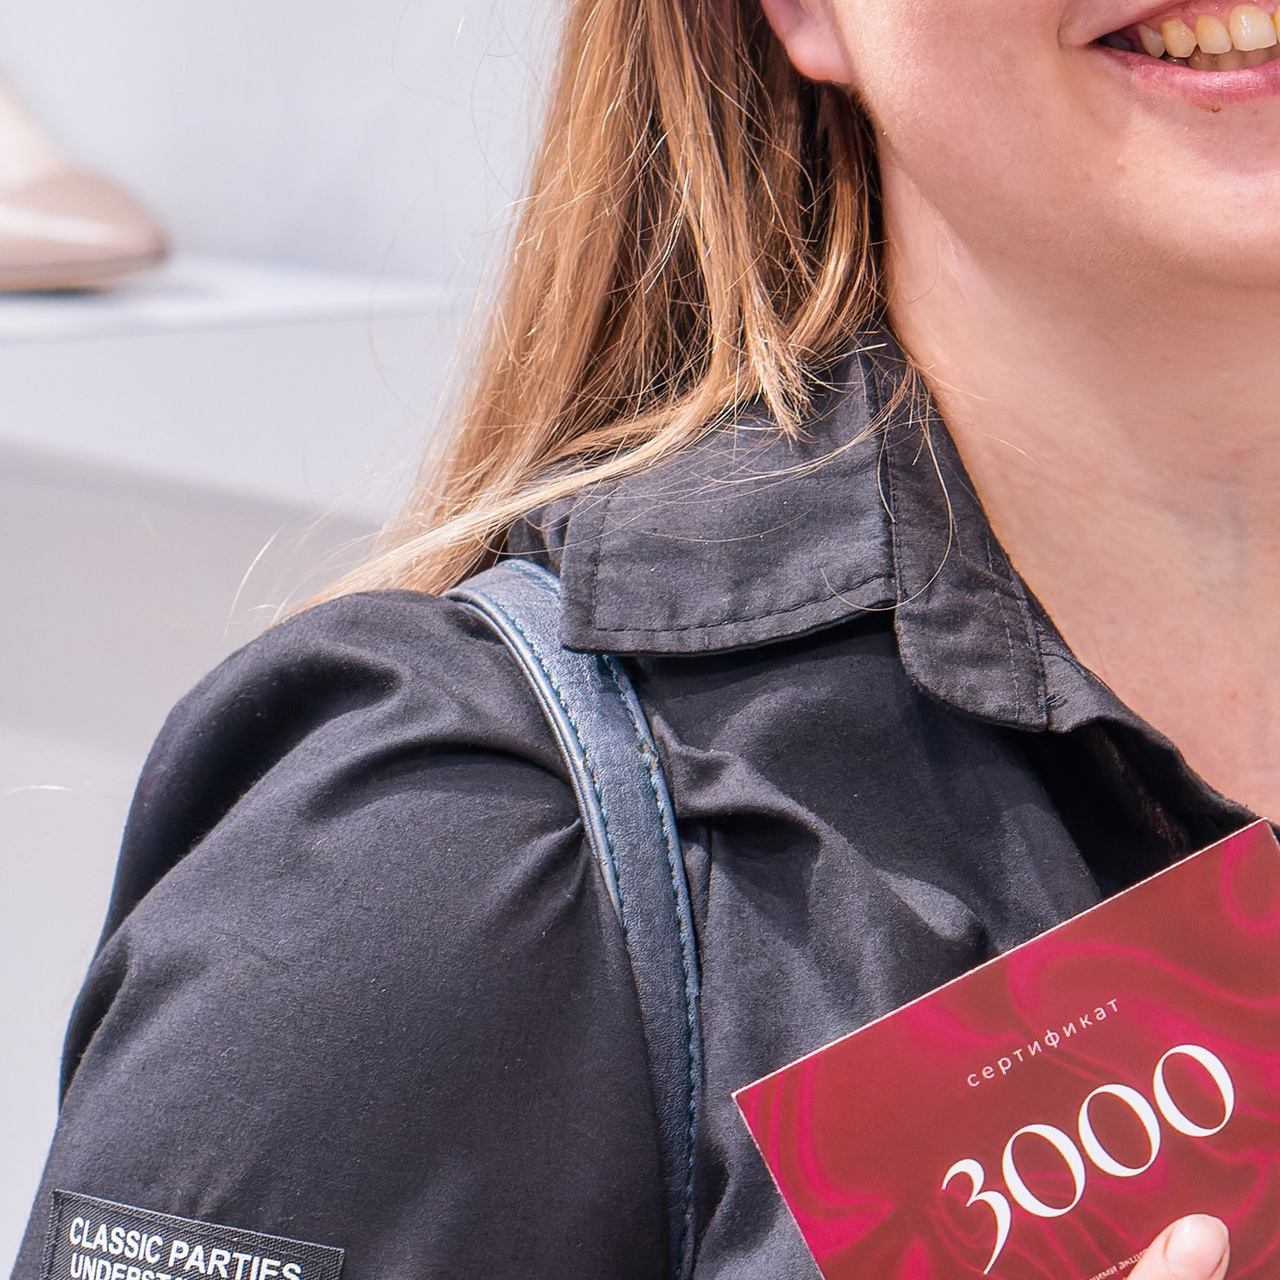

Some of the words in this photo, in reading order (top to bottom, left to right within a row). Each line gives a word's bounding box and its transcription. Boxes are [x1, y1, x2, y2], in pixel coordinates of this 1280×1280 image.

[966, 998, 1118, 1088] сертификат
[941, 1043, 1236, 1276] 3000
[69, 1216, 164, 1265] CLASSIC
